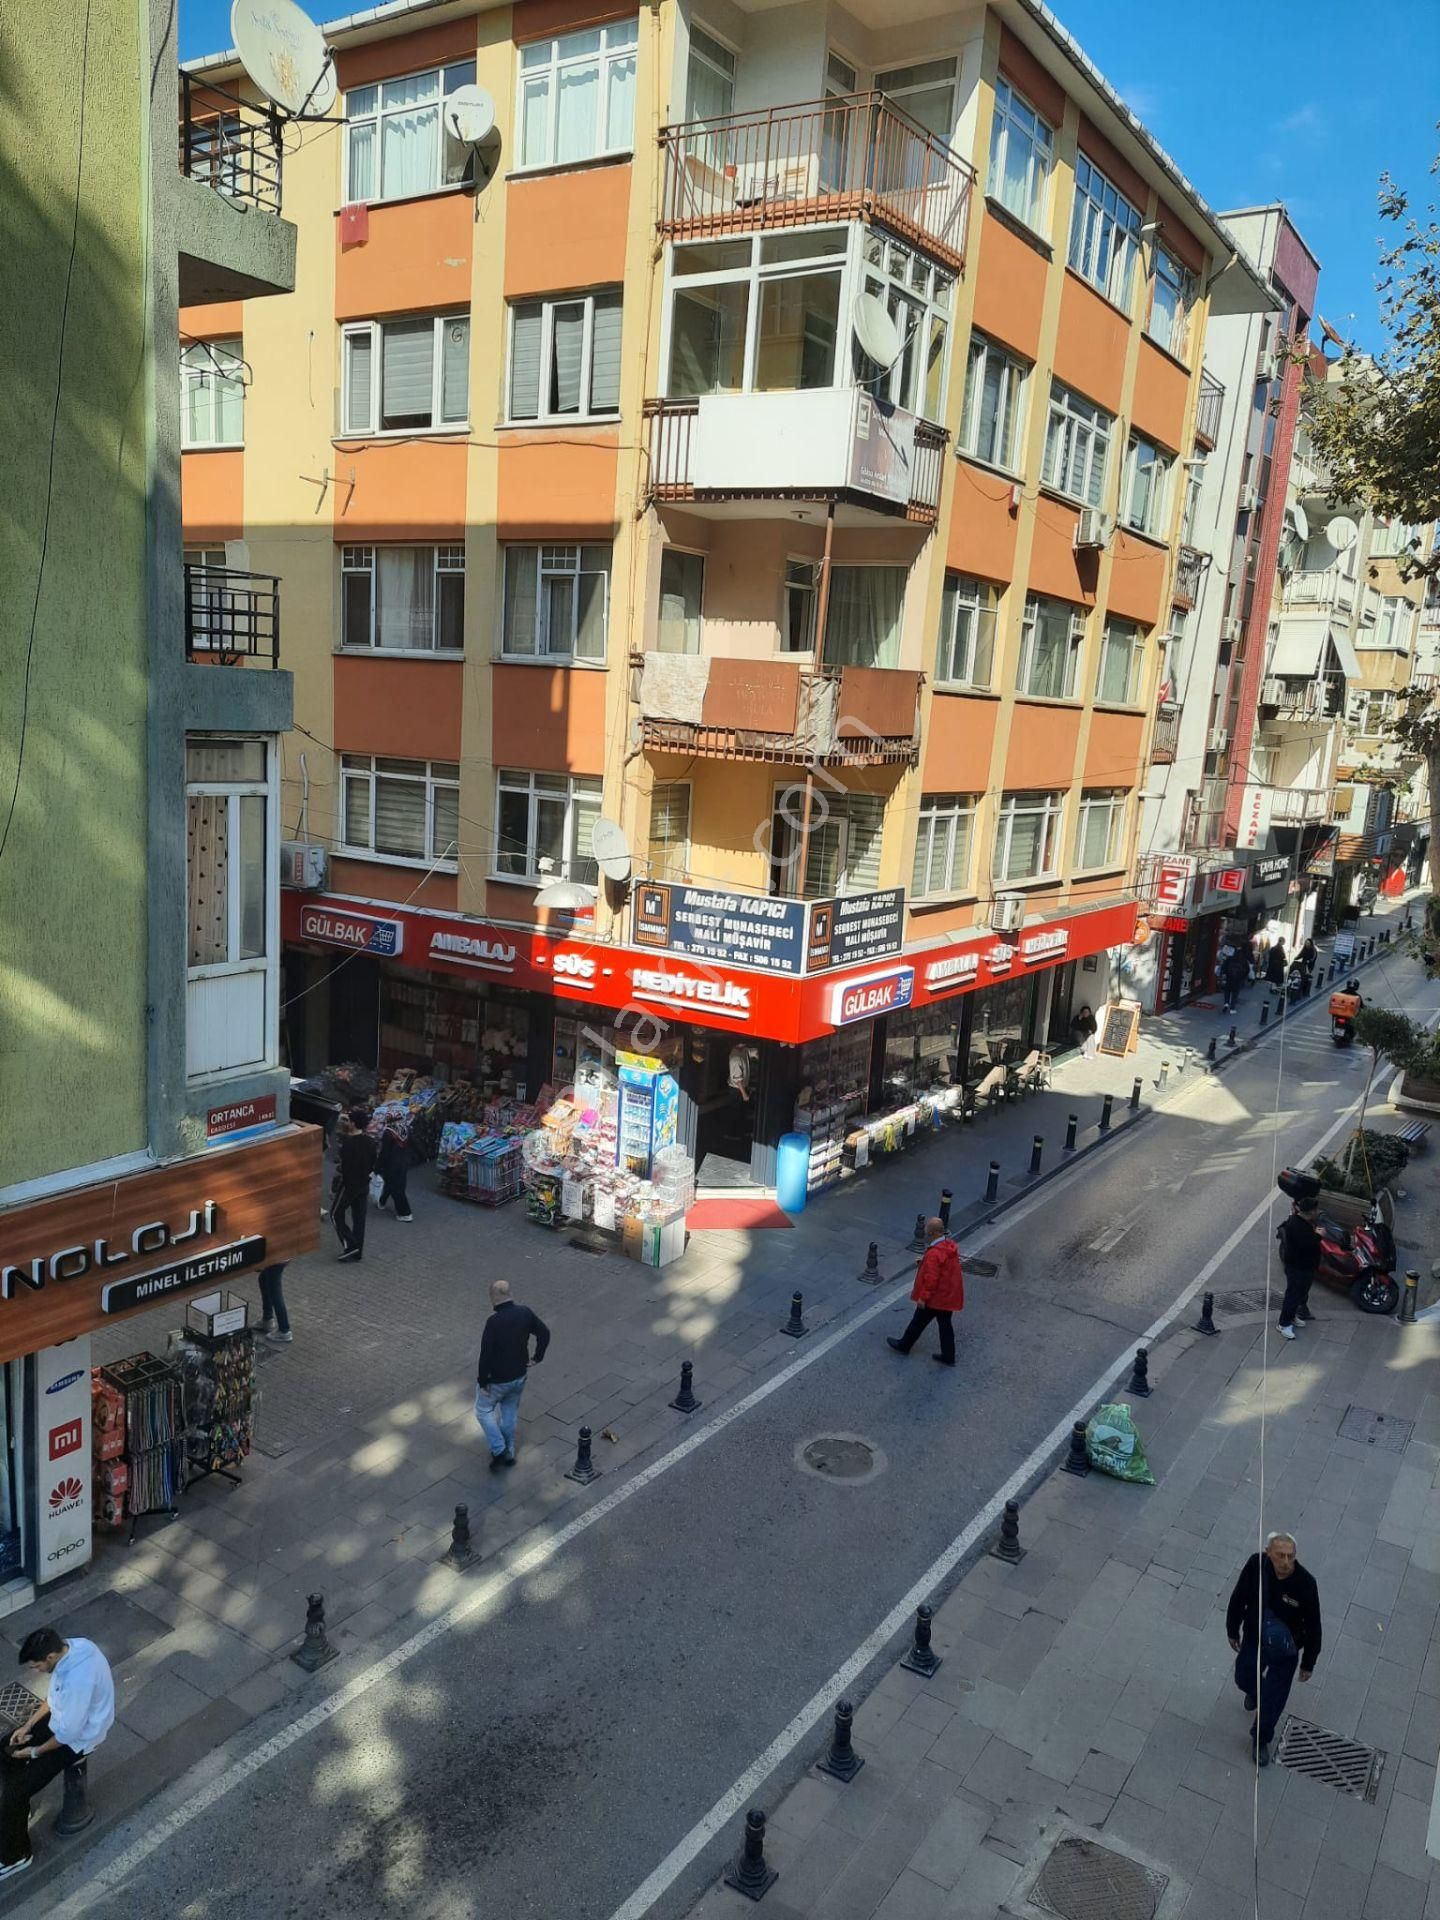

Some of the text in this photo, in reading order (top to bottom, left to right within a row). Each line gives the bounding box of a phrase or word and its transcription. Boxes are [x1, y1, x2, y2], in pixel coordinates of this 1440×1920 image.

[1247, 793, 1262, 847] ECZANE
[1159, 869, 1181, 901] E
[684, 890, 787, 919] Mustafa KAPICI
[840, 897, 870, 916] Mustafa
[306, 914, 367, 944] GÜLBAK
[675, 910, 793, 940] SERBEST MUHASEBECİ
[834, 911, 898, 935] SERBEST MUHASEBECİ
[673, 940, 685, 950] TEL
[694, 927, 771, 950] MALİ MÜŞAVİR
[845, 928, 887, 946] MALİ MÜŞAVİR
[430, 932, 516, 963] AMBALAJ
[552, 953, 597, 979] SÜS
[633, 969, 751, 1007] HEDİYELİK
[844, 985, 894, 1017] GÜLBAK
[211, 1104, 255, 1124] ORTANCA
[136, 1249, 243, 1299] MİNEL İLETİŞİM
[50, 1373, 82, 1391] SAMSUNG
[48, 1498, 84, 1520] HUAWEI
